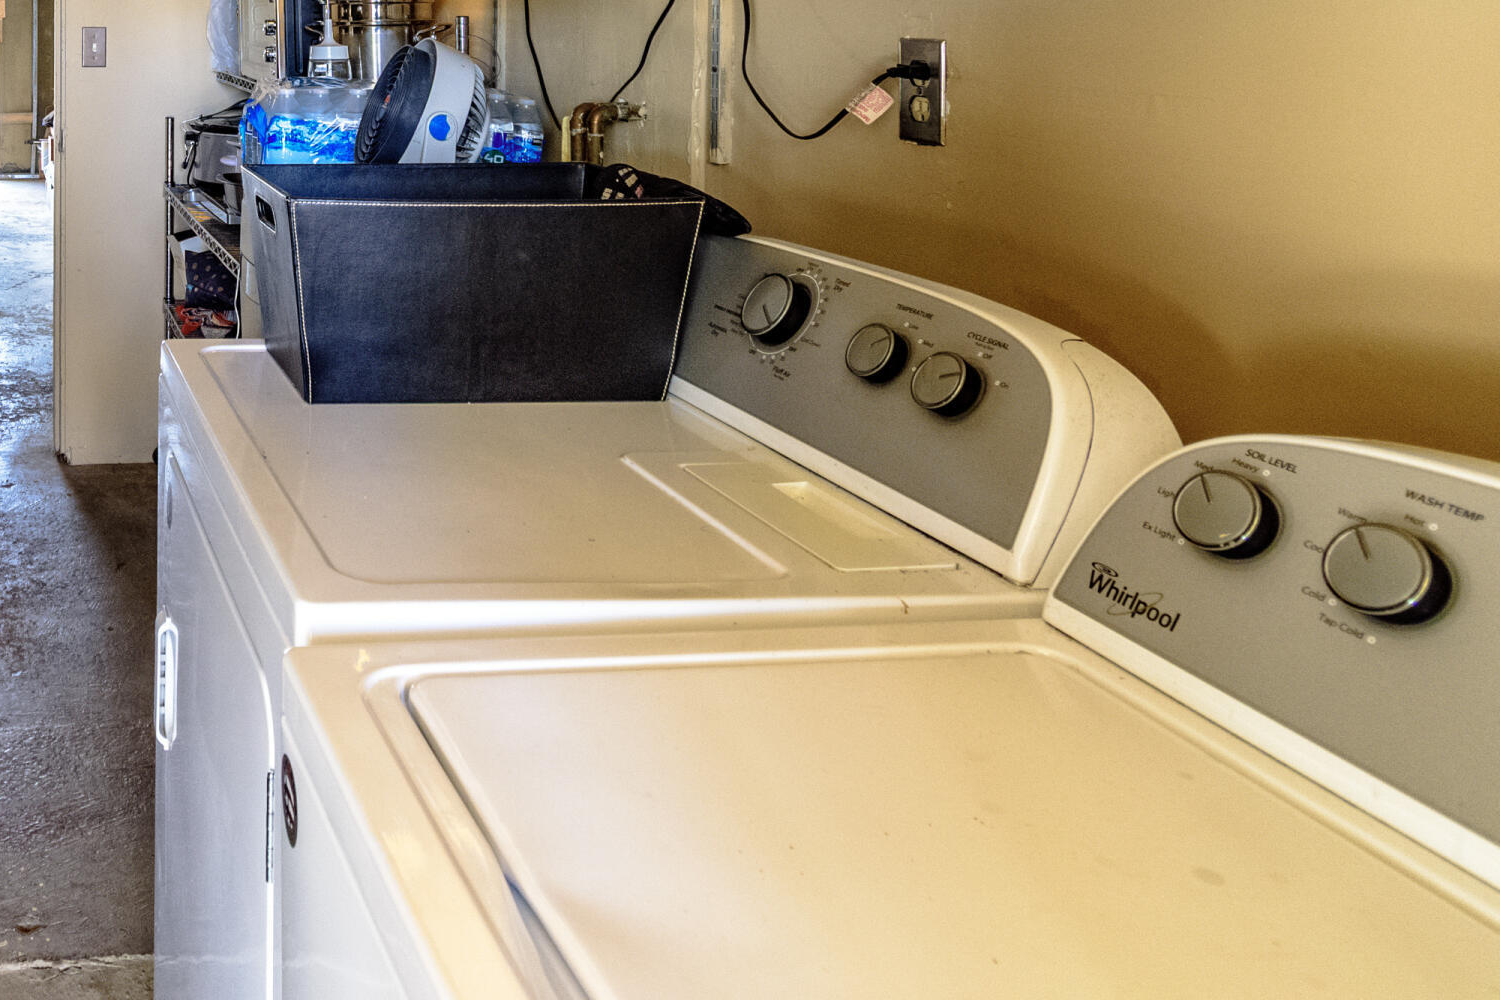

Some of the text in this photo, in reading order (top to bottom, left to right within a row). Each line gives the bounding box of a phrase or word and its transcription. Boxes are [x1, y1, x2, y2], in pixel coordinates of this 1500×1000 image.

[1231, 457, 1261, 474] Heavy
[1244, 448, 1299, 474] SOIL LEVEL
[1157, 486, 1177, 499] Ligh
[1404, 488, 1485, 522] WASH TEMP
[1403, 513, 1426, 527] Hot
[1153, 526, 1177, 542] Light
[1303, 539, 1326, 554] Coo
[1088, 569, 1181, 632] Whirlpool
[1301, 585, 1327, 602] Cold
[1318, 612, 1365, 640] Tap Cold
